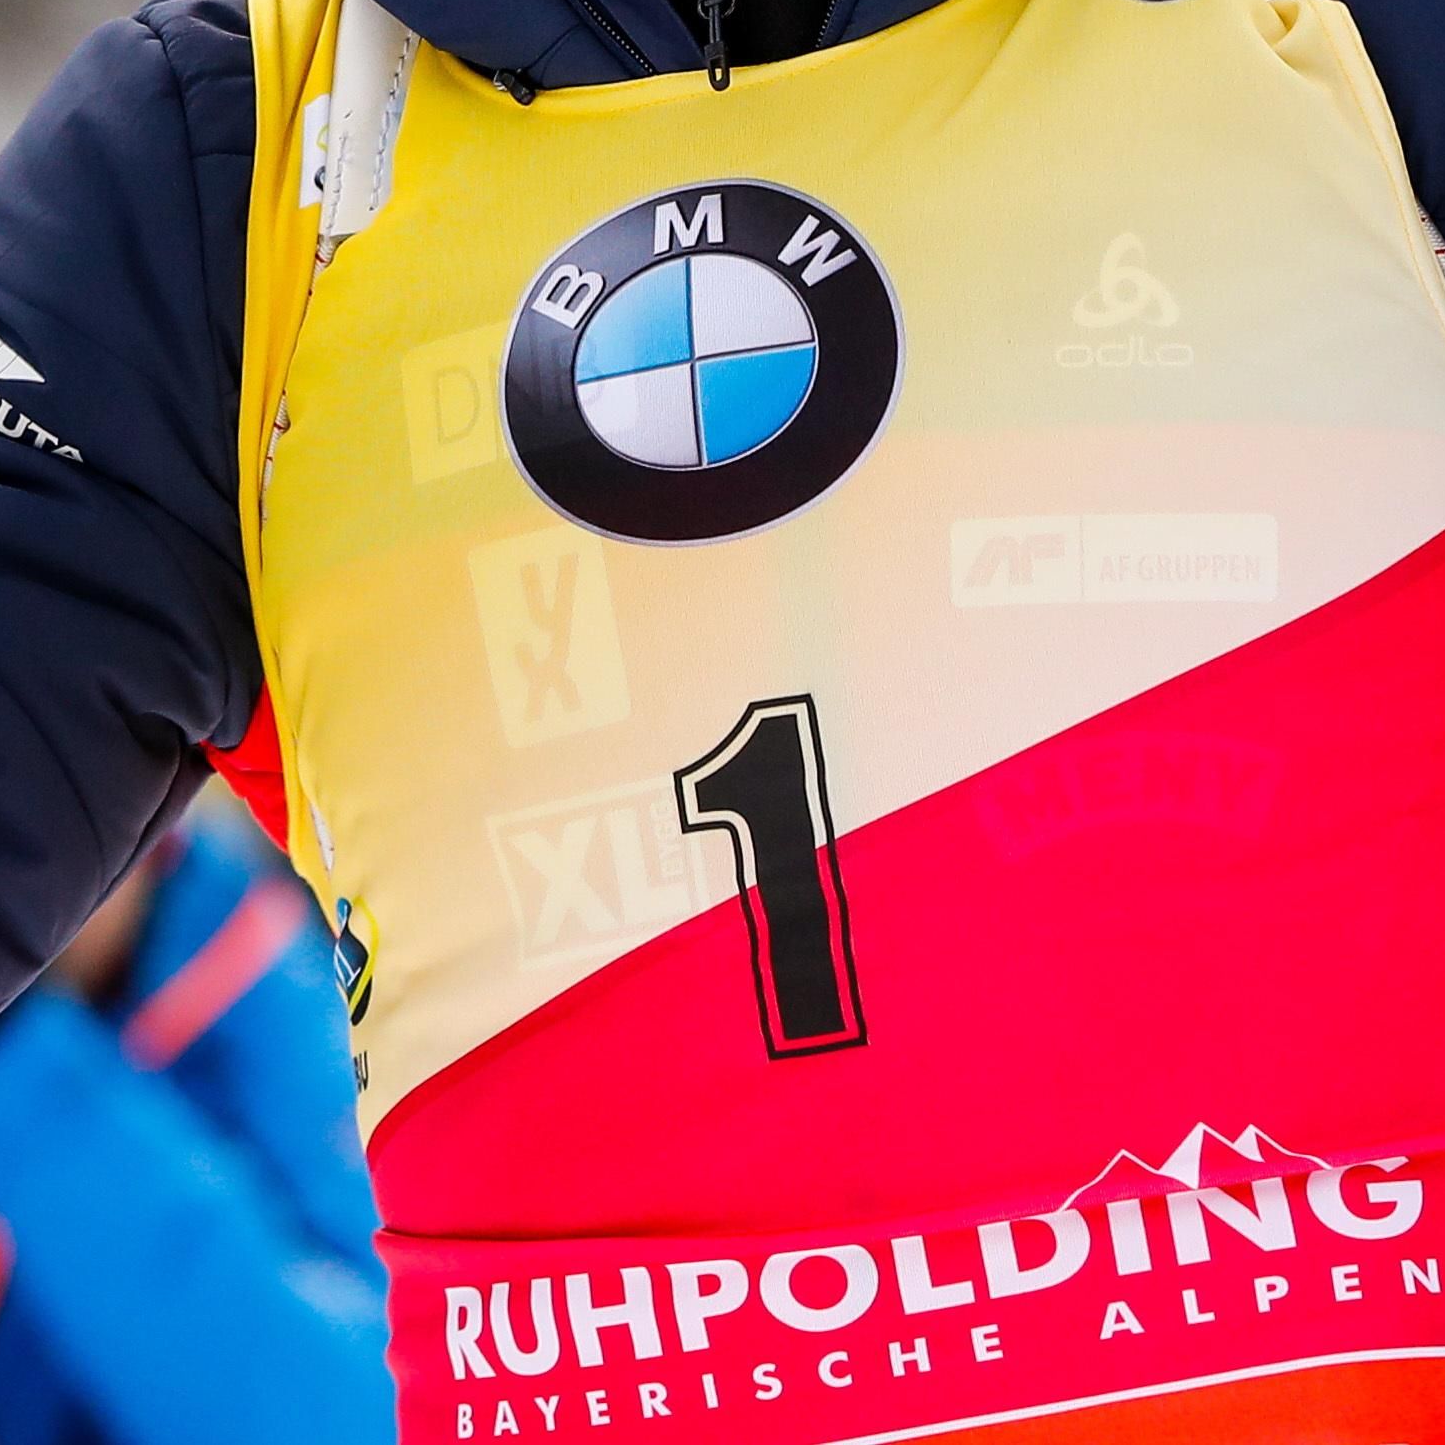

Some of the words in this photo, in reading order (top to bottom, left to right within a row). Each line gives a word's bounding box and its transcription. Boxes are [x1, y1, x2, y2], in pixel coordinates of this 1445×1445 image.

[530, 192, 859, 330] BMW
[1055, 334, 1194, 368] odlo
[673, 693, 870, 1062] 1
[444, 1155, 1424, 1381] RUHPOLDING
[456, 1324, 1004, 1440] BAYERISCHE
[1099, 1257, 1443, 1341] ALPEN
